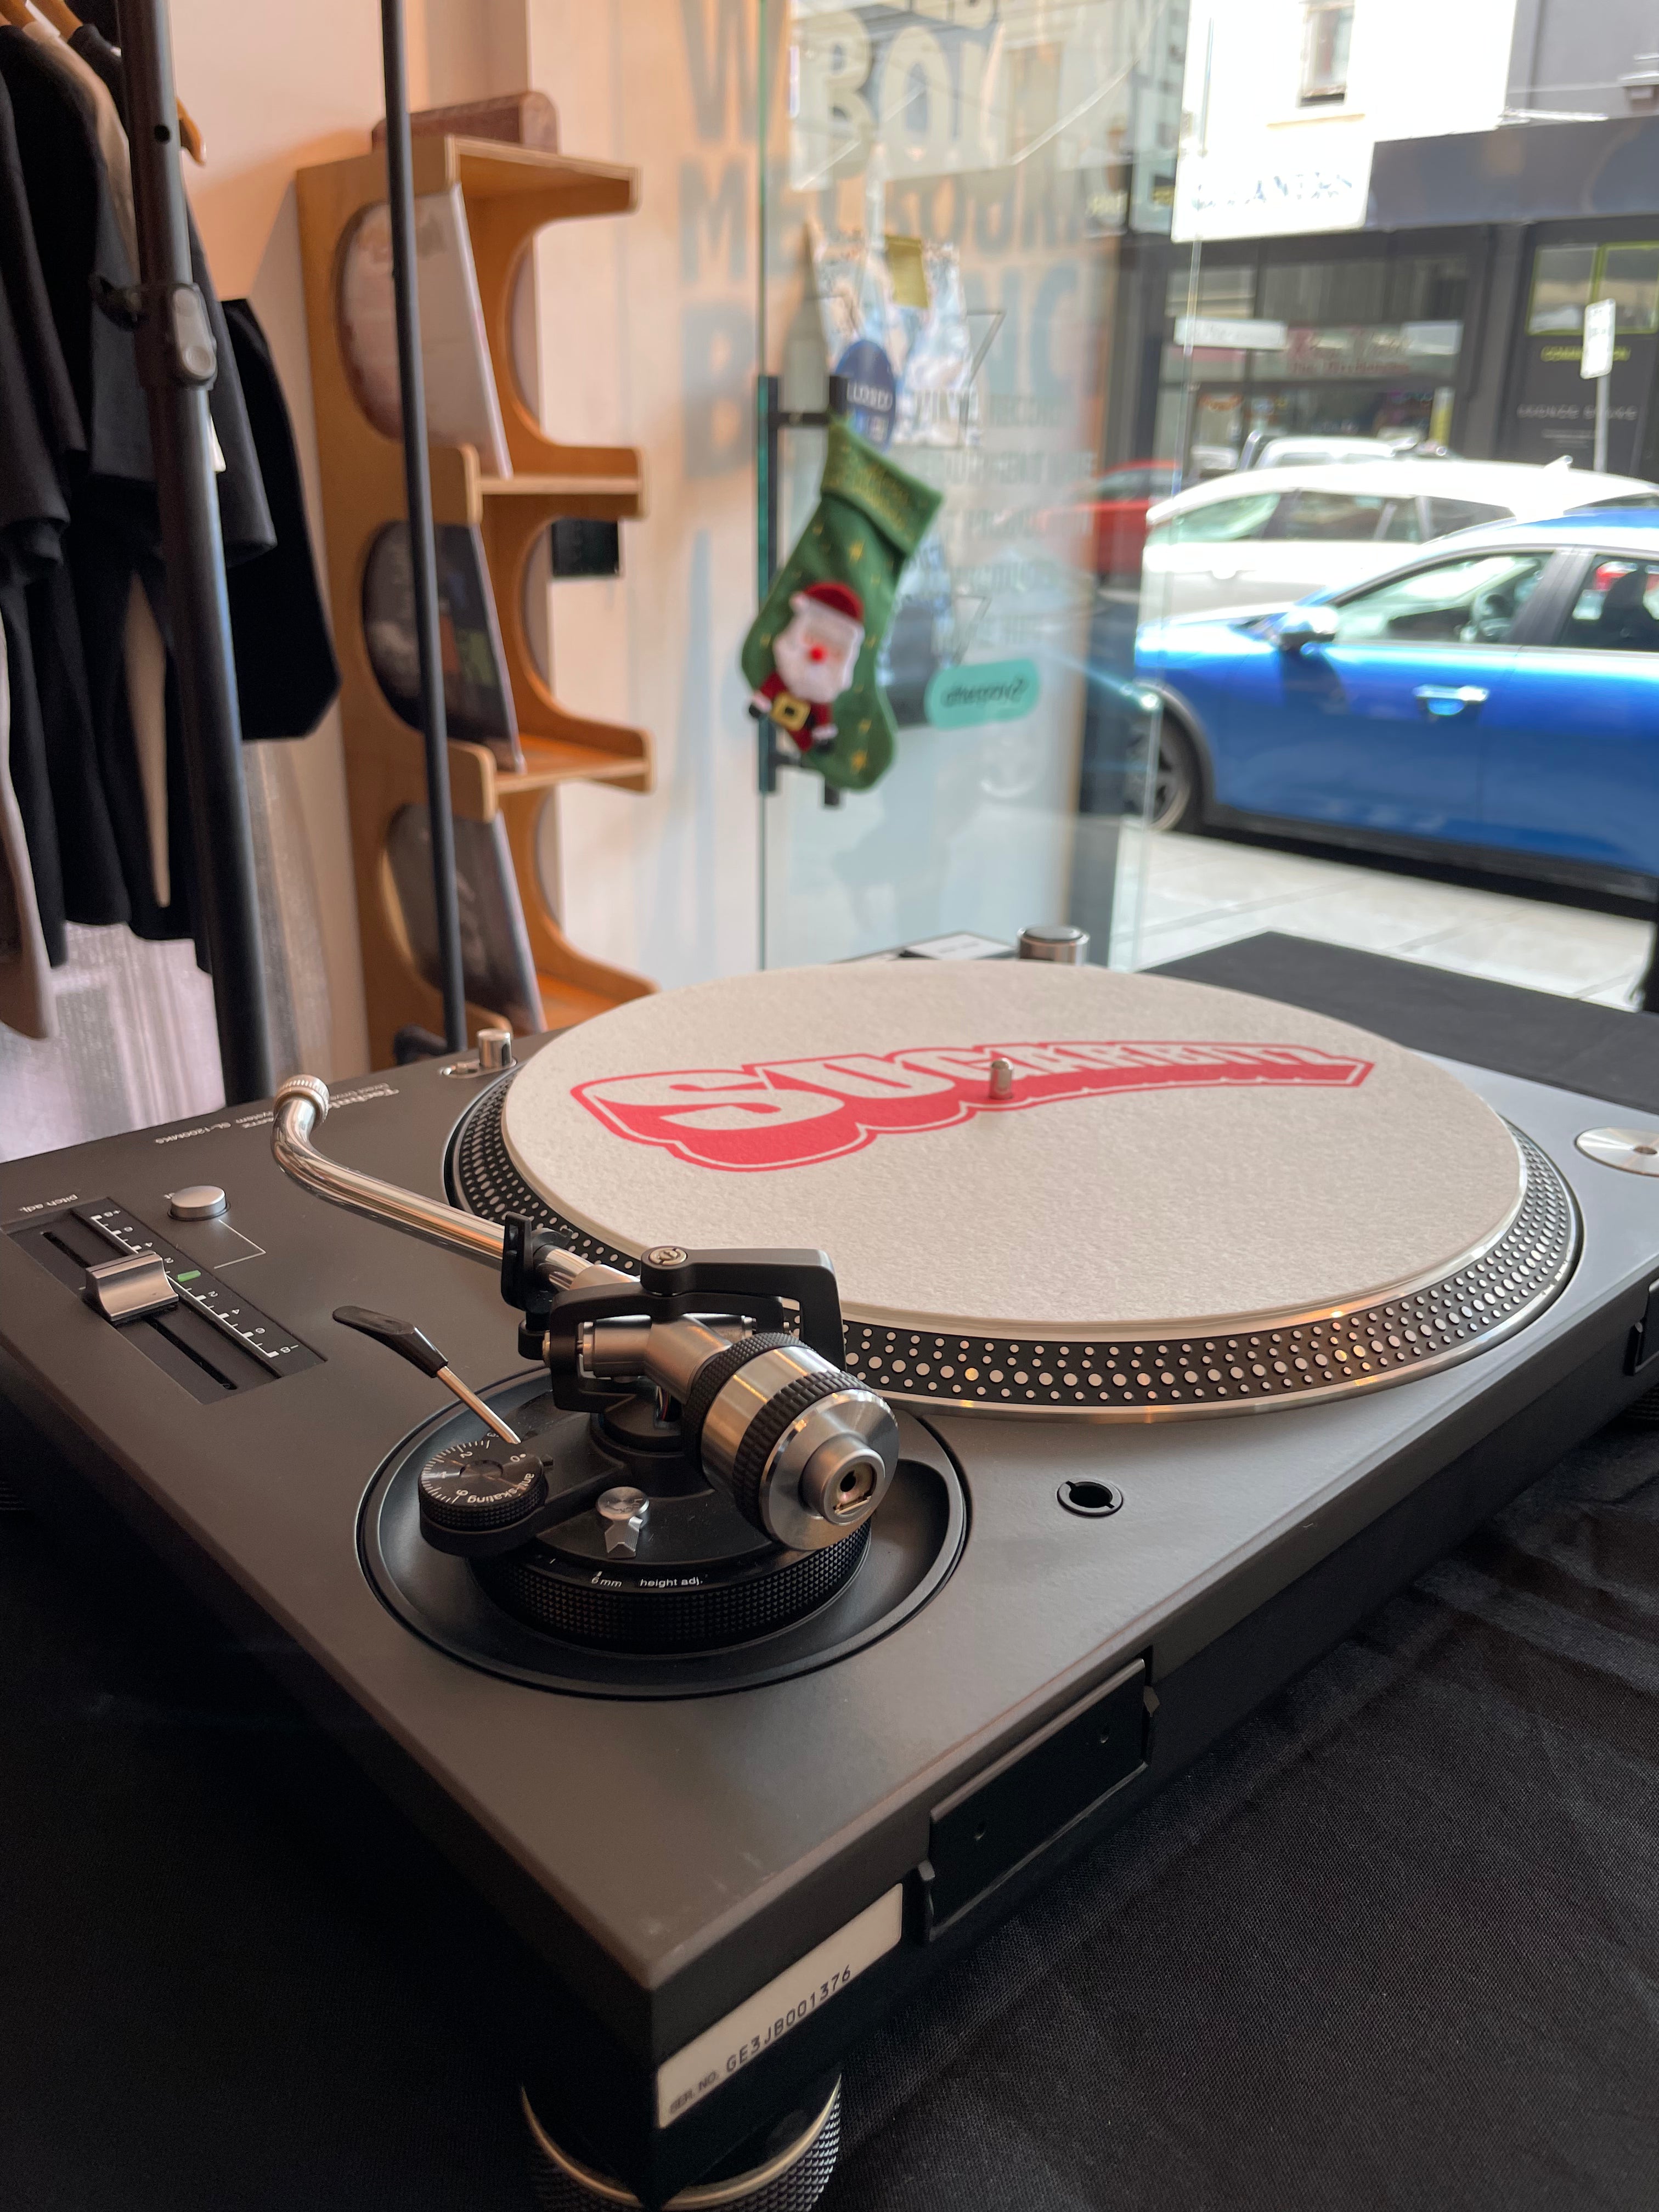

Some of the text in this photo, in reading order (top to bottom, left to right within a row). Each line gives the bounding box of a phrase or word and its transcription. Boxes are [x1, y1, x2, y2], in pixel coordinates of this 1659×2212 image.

[46, 1193, 78, 1207] pitch
[439, 1471, 448, 1479] 4
[467, 1473, 535, 1503] anti-skating
[640, 1578, 678, 1588] height
[681, 1576, 703, 1585] adj.
[726, 1964, 851, 2073] GE3JB001376
